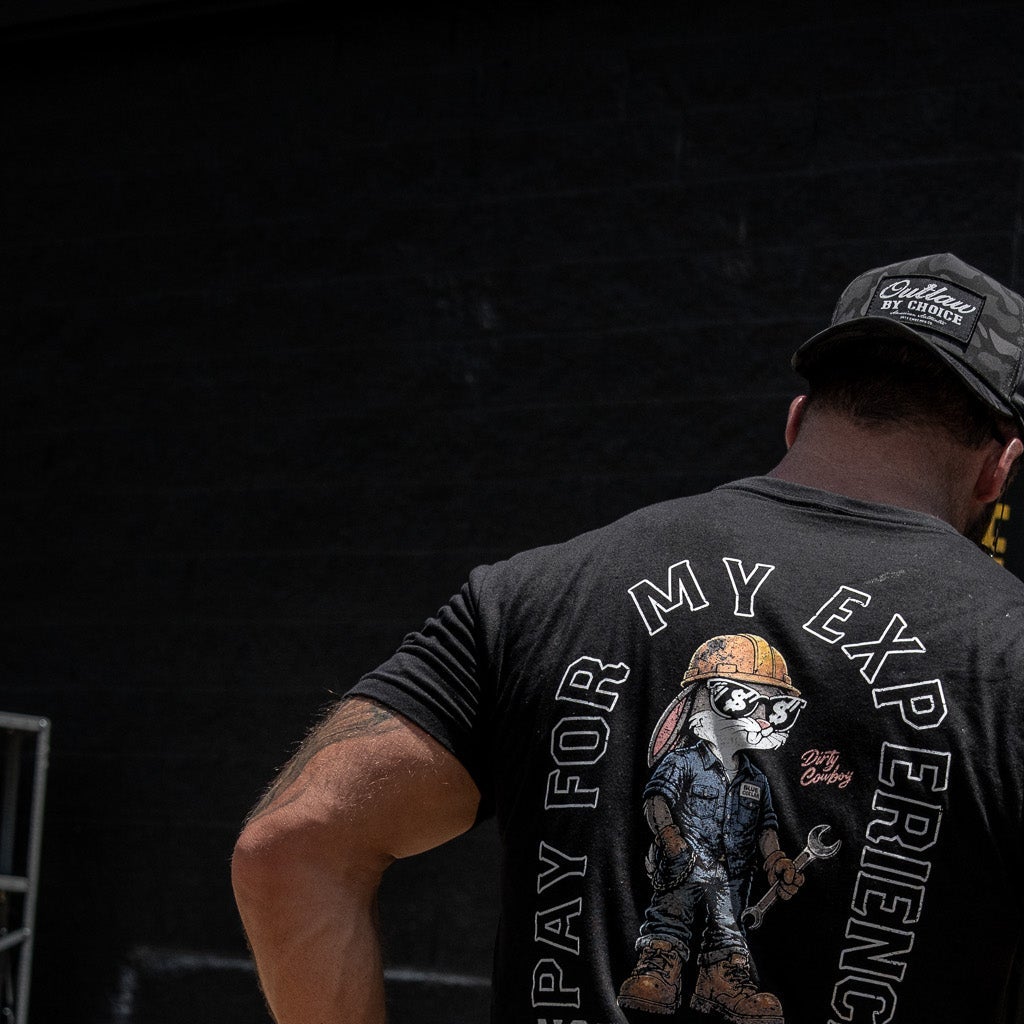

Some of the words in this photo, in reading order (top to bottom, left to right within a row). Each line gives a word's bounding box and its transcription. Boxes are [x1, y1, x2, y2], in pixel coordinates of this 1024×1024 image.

[879, 279, 976, 314] Outlaw
[880, 300, 902, 310] BY
[907, 300, 963, 326] CHOICE
[627, 556, 776, 637] MY
[544, 655, 631, 811] FOR
[800, 764, 854, 789] Cowboy
[801, 748, 840, 772] Dirty
[531, 840, 588, 1009] PAY
